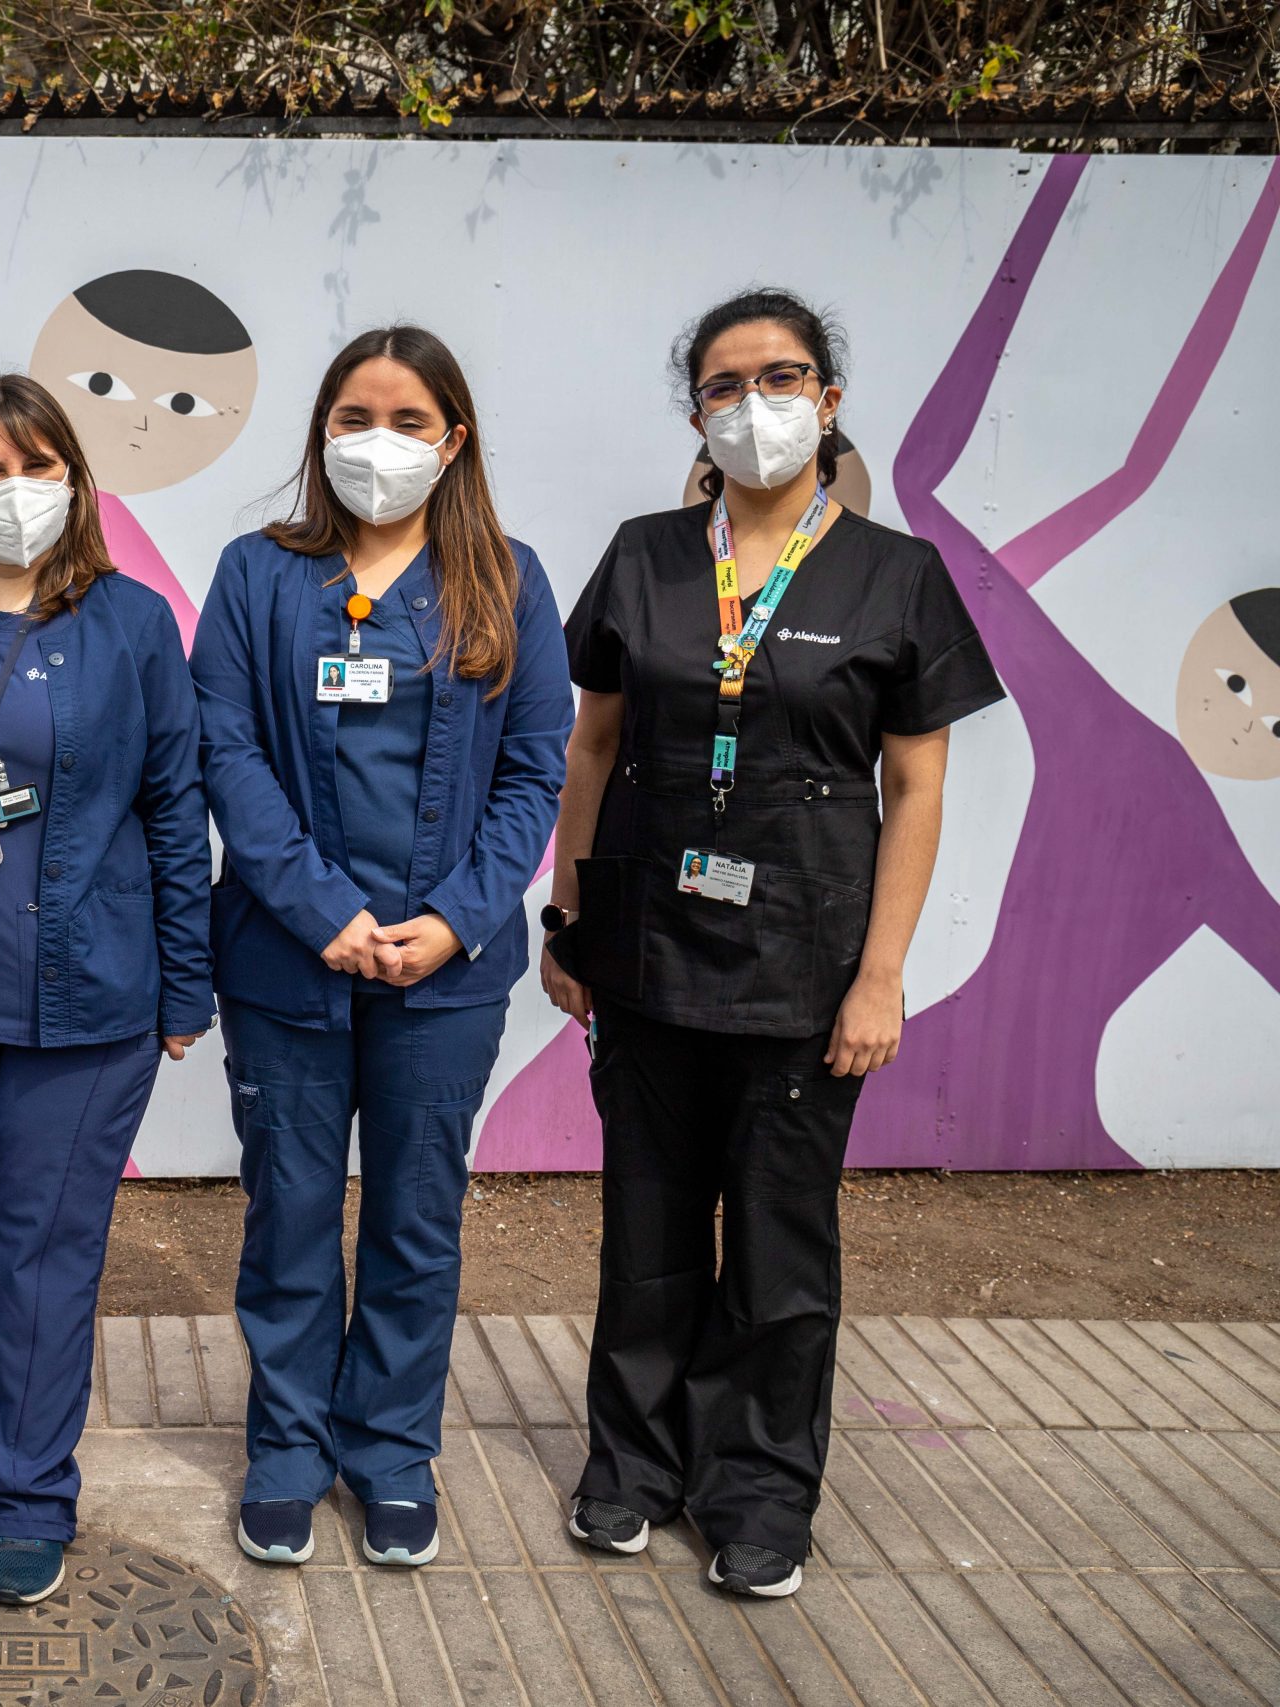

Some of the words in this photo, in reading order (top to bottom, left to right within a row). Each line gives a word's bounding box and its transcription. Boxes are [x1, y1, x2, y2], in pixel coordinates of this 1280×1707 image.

[784, 540, 800, 562] Ketamine
[725, 567, 733, 588] Propofol
[729, 600, 737, 631] Rocuronium
[723, 741, 731, 768] Atropine
[715, 861, 746, 873] NATALIA
